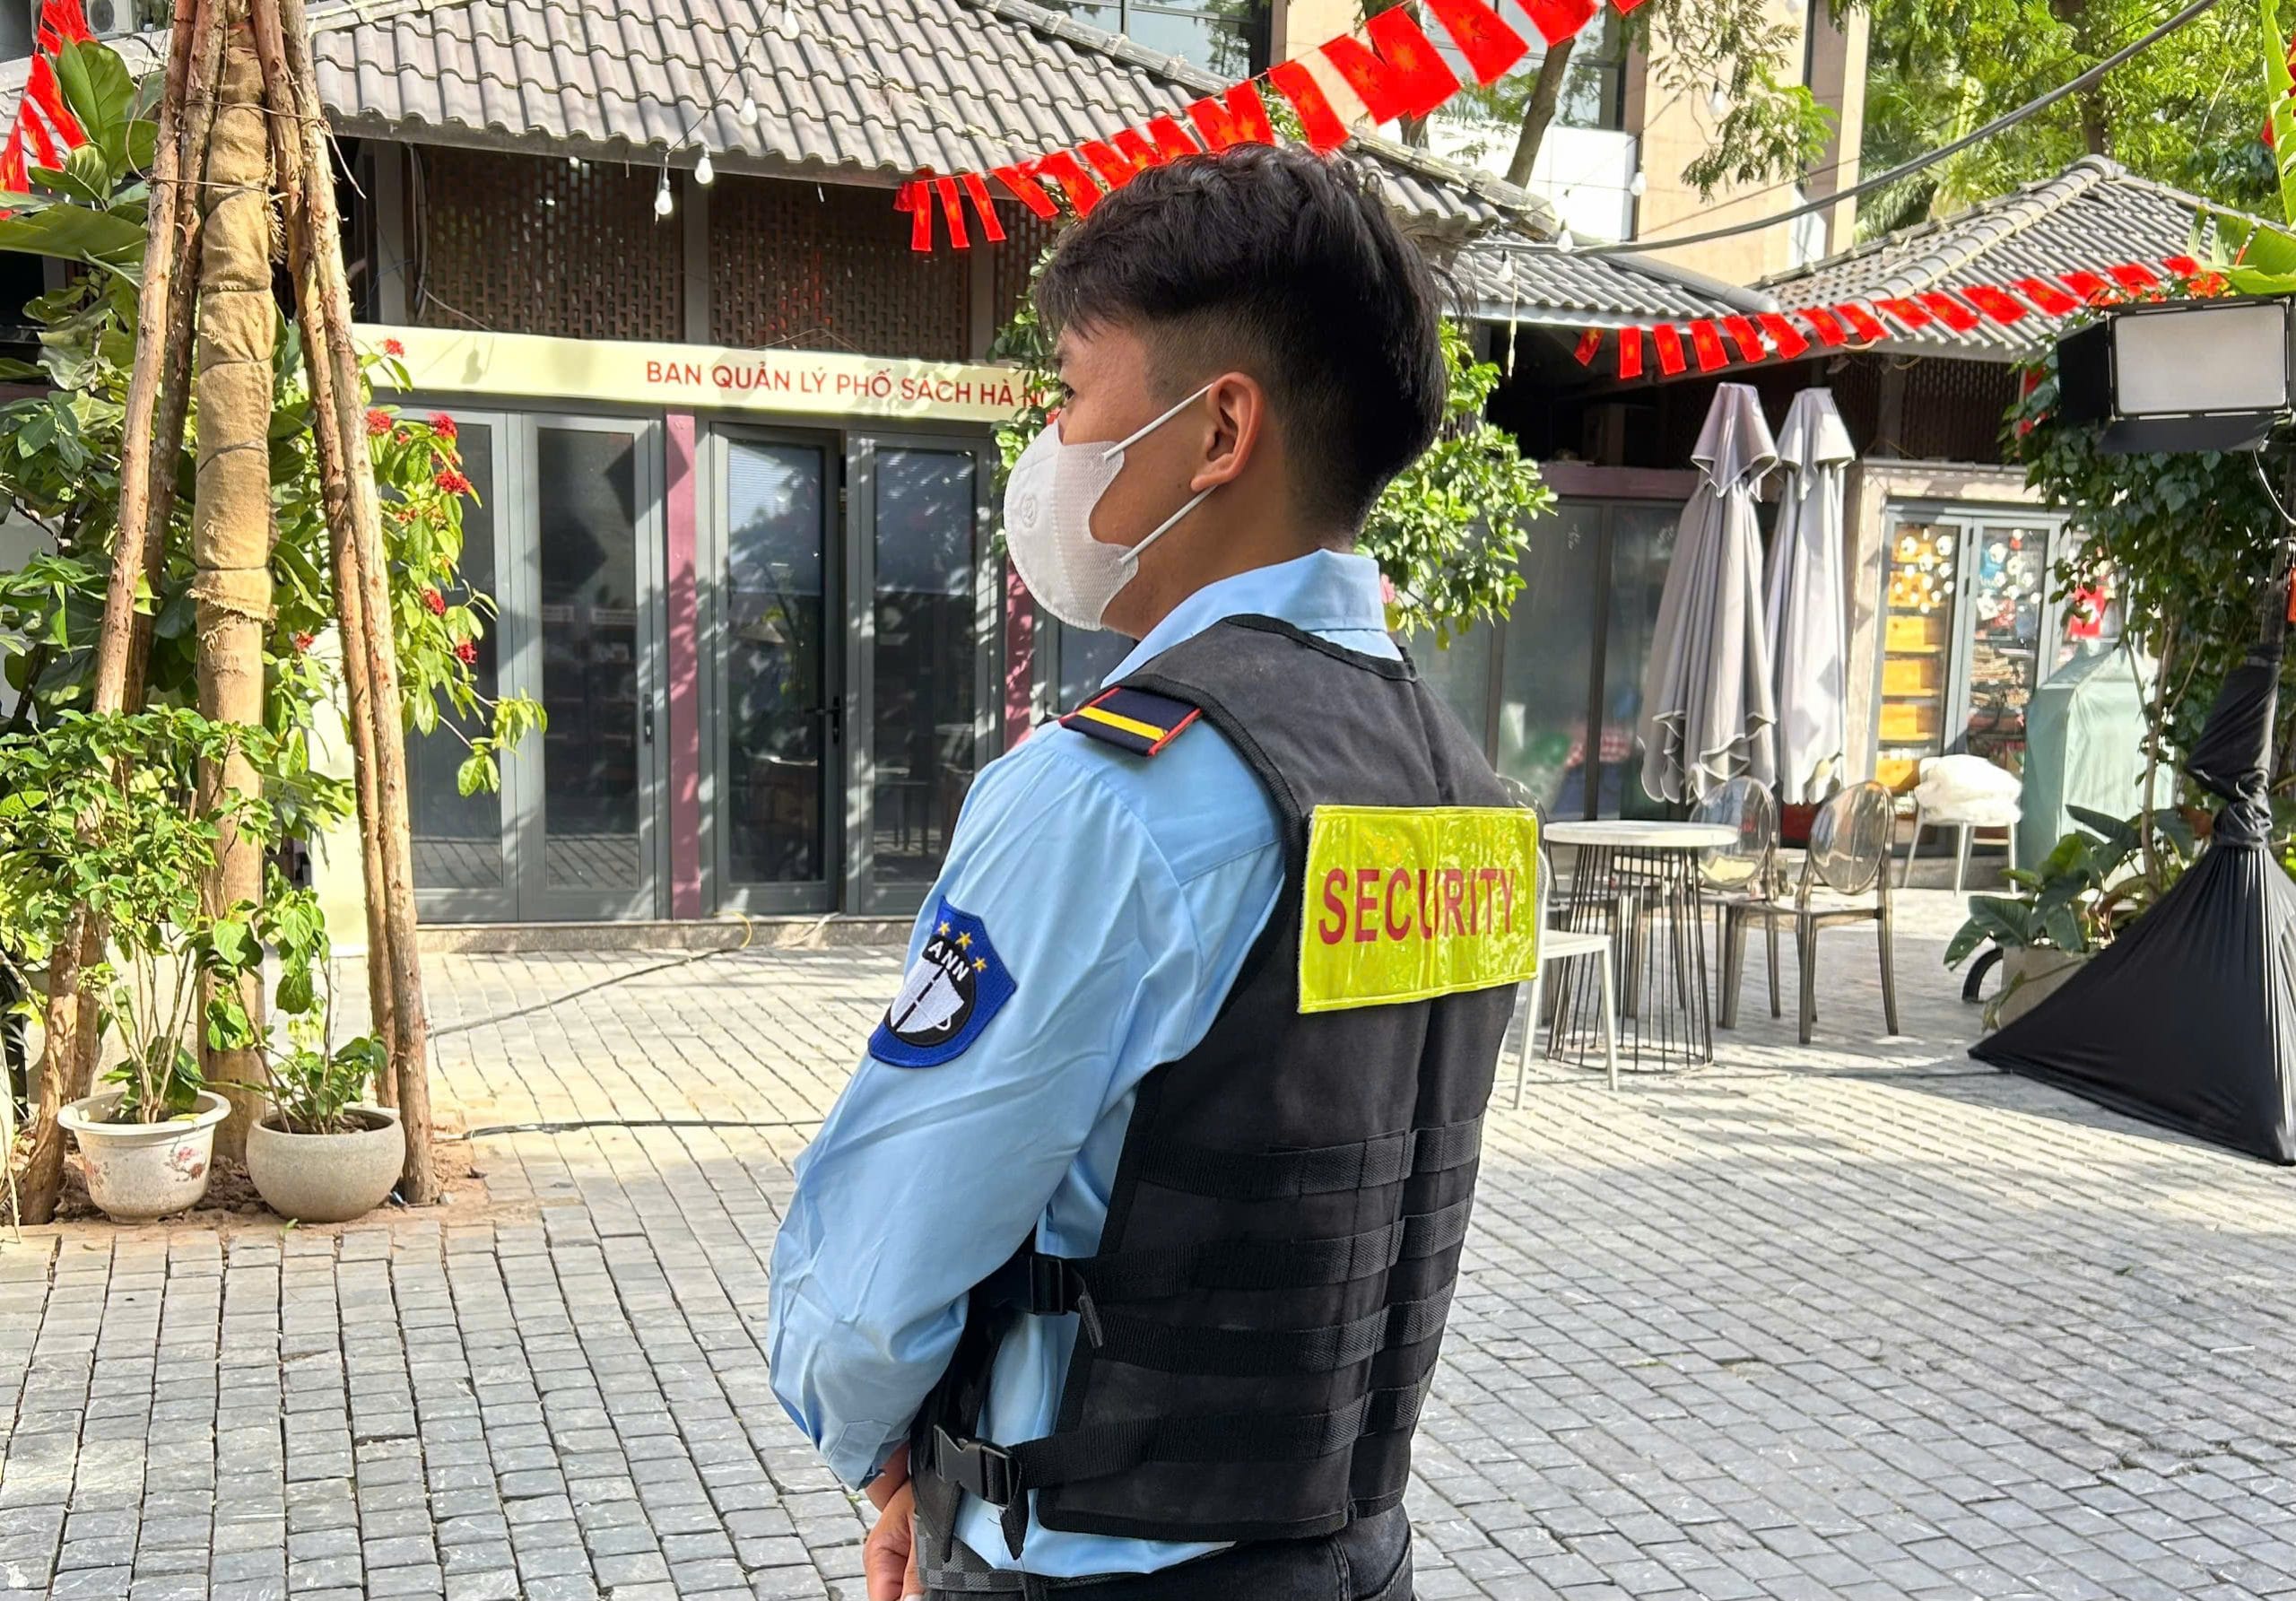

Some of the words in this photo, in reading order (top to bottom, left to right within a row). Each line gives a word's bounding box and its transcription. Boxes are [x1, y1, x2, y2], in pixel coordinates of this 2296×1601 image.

[647, 361, 701, 386] BAN
[712, 361, 790, 391] QUẢN
[801, 366, 827, 393] LÝ
[836, 369, 891, 398] PHỐ
[900, 373, 971, 404] SÁCH
[980, 378, 1014, 406] HÀ
[1318, 867, 1515, 945] SECURITY
[927, 941, 970, 982] ANN
